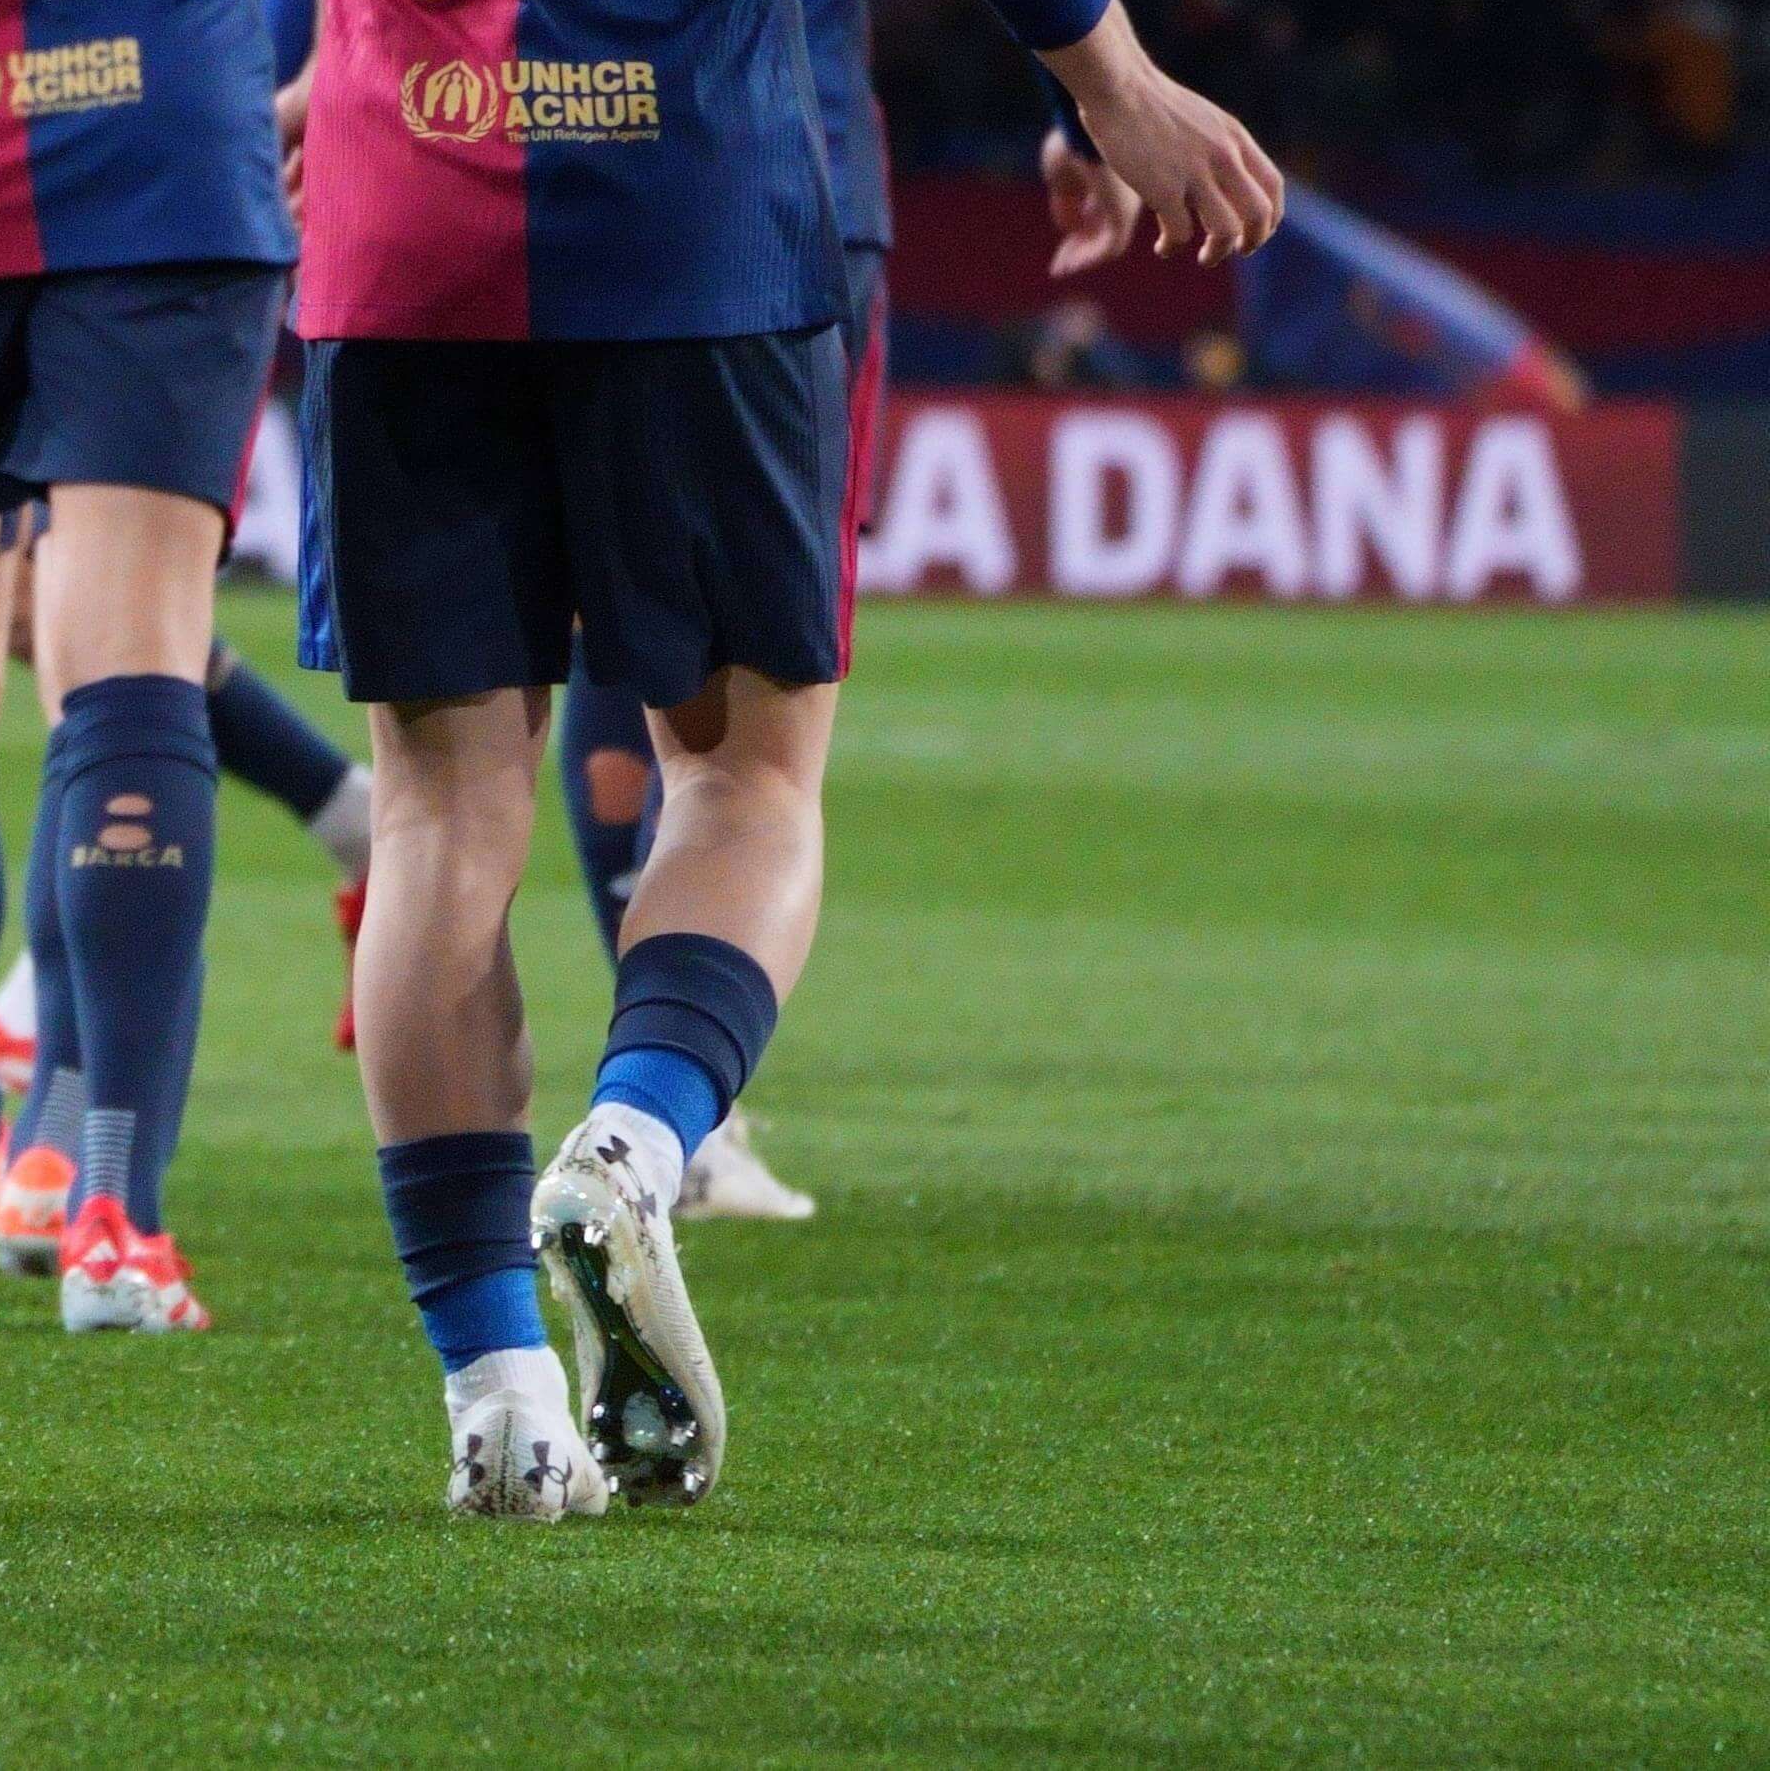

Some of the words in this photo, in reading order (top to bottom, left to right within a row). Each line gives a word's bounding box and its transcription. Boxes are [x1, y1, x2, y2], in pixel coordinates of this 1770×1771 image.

[8, 37, 140, 80] UNHCR
[10, 65, 141, 105] ACNUR
[500, 61, 657, 94] UNHCR
[505, 94, 660, 128] ACNUR
[507, 131, 530, 143] The
[531, 130, 552, 142] UN
[553, 130, 609, 144] Refugee
[610, 131, 660, 143] Agency
[1049, 408, 1585, 602] DANA
